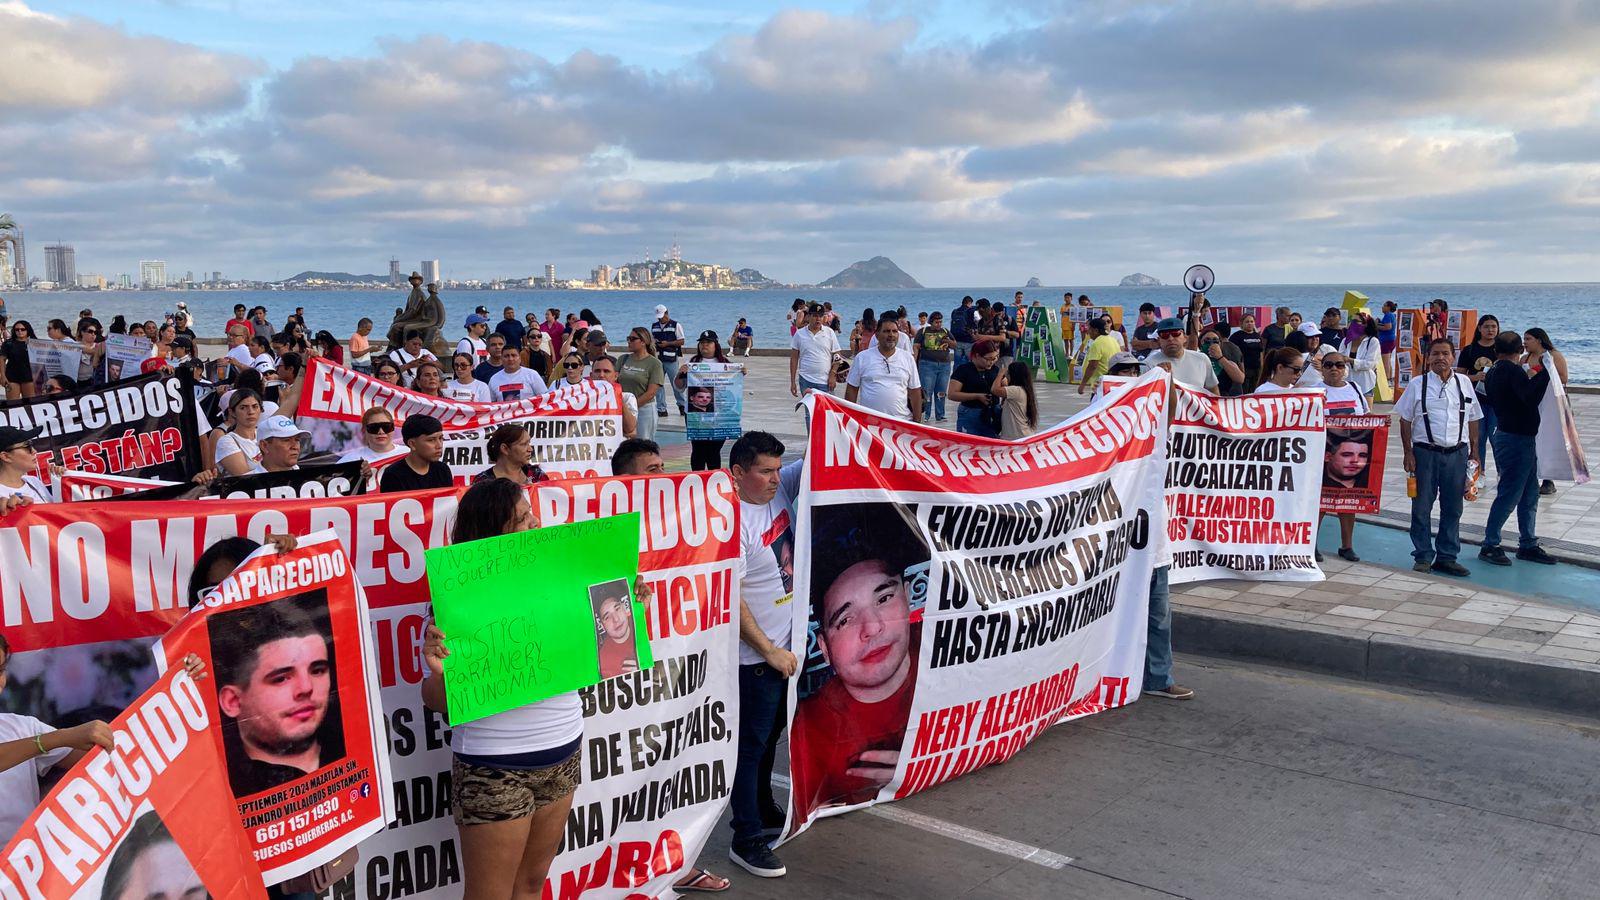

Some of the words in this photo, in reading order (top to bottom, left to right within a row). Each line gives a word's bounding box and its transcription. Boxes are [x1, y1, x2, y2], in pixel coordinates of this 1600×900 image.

[485, 419, 616, 440] AORIDADES
[825, 410, 872, 467] NO
[879, 427, 943, 476] MAS
[940, 391, 1162, 477] DESAPARECIDOS
[1218, 397, 1324, 430] JUSTICIA
[1325, 417, 1386, 427] SAPARECIDO
[61, 427, 183, 476] ESTÁN?
[442, 446, 482, 466] ARA
[1278, 465, 1294, 491] A
[928, 500, 1043, 552] EXIGIMOS
[1043, 477, 1123, 540] JUSTICIA
[1190, 518, 1312, 544] BUSTAMANTE
[0, 521, 111, 627] NO
[938, 560, 969, 610] LO
[964, 542, 1078, 610] QUEREMOS
[1072, 533, 1103, 582] DE
[1173, 550, 1205, 570] PUEDE
[1205, 552, 1266, 571] QUEDAR
[1268, 555, 1317, 570] IMPUNE
[930, 610, 1012, 669] HASTA
[1011, 570, 1120, 653] ENCONTRARLO
[578, 649, 708, 719] BUSCANDO
[911, 700, 982, 758] NERY
[976, 662, 1079, 742] ALEJANDRO
[589, 733, 624, 781] DE
[629, 717, 686, 772] ESTE
[682, 696, 732, 752] PAÍS,
[284, 789, 326, 815] VILLALOBOS
[327, 768, 369, 796] BUSTAMANTE
[255, 821, 285, 843] 667
[288, 811, 310, 832] 157
[311, 797, 339, 821] 1930
[366, 839, 460, 900] CADA
